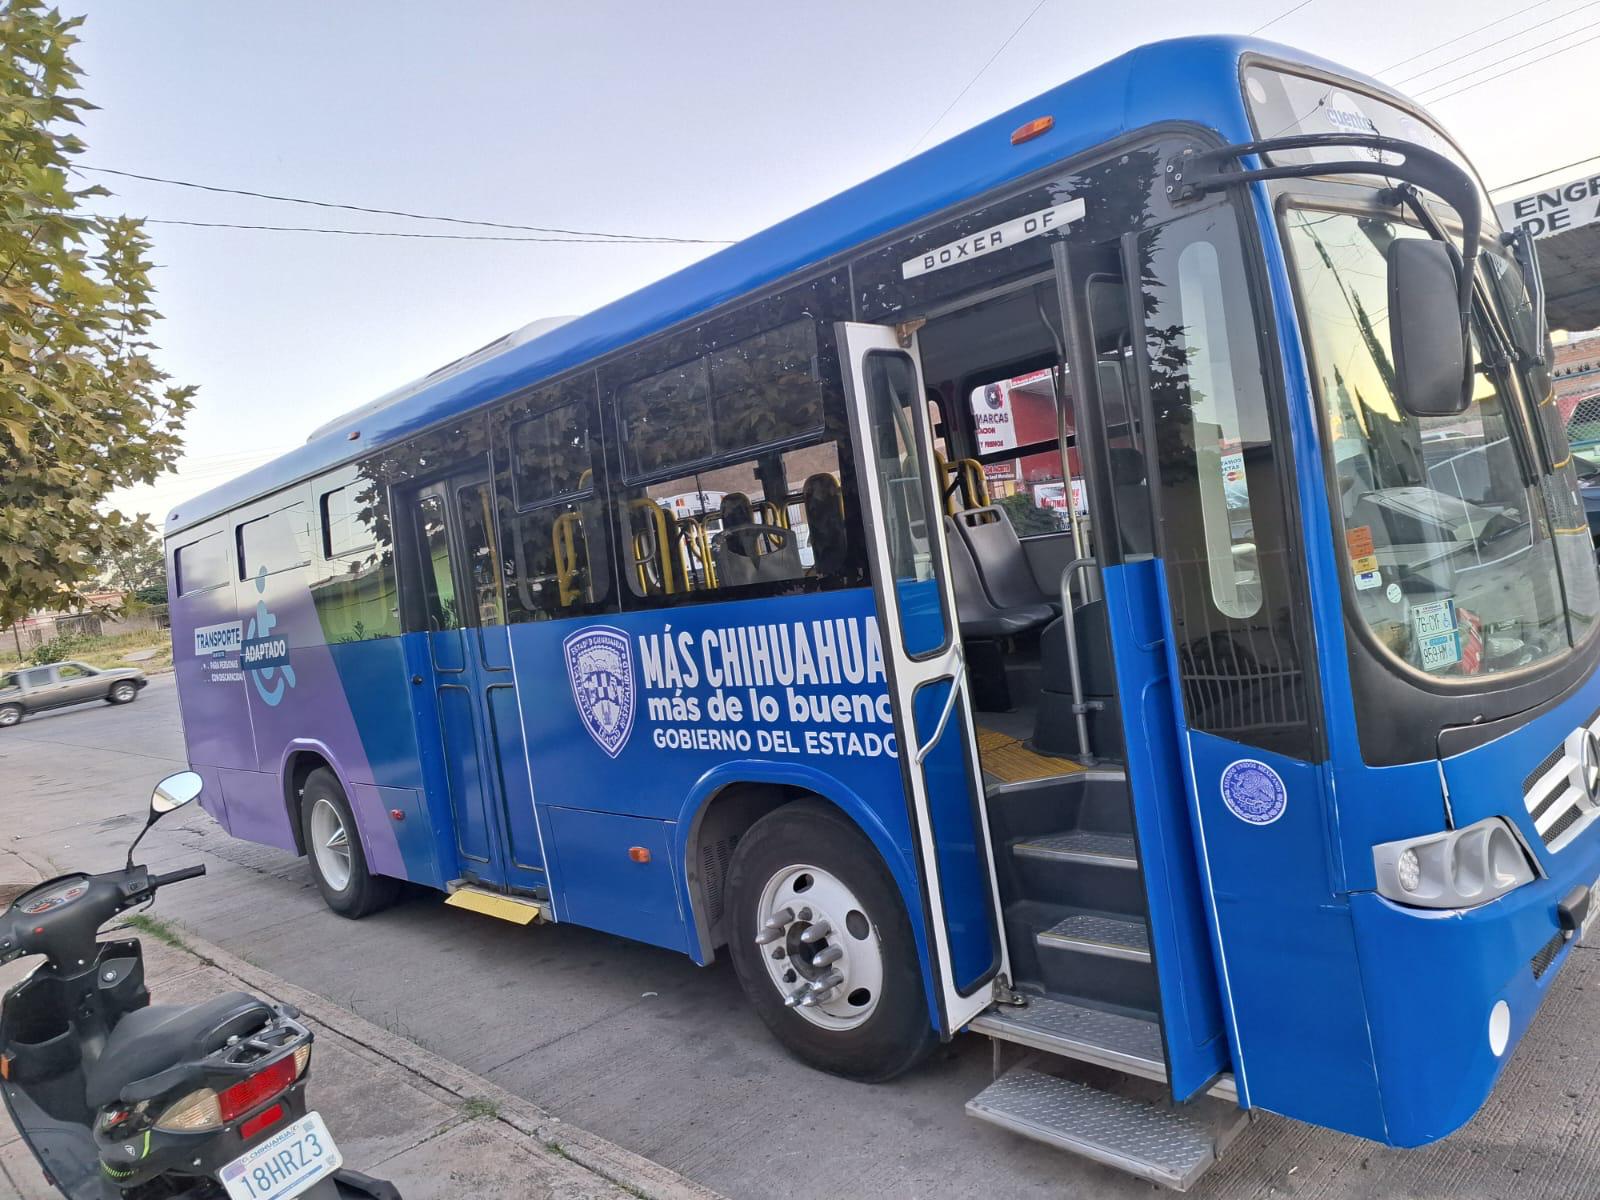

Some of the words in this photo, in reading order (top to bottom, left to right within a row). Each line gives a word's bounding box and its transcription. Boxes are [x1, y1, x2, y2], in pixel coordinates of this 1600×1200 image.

[1522, 208, 1571, 237] DE
[924, 231, 1003, 270] BOXER
[1024, 210, 1056, 234] OF
[196, 627, 241, 649] TRANSPORTE
[245, 639, 286, 662] ADAPTADO
[639, 624, 699, 689] MÁS
[702, 616, 887, 688] CHIHUAHUA
[648, 689, 702, 722] más
[707, 688, 743, 722] de
[750, 688, 780, 722] lo
[653, 728, 751, 752] GOBIERNO
[757, 730, 800, 753] DEL
[241, 1133, 323, 1199] 18HRZ3
